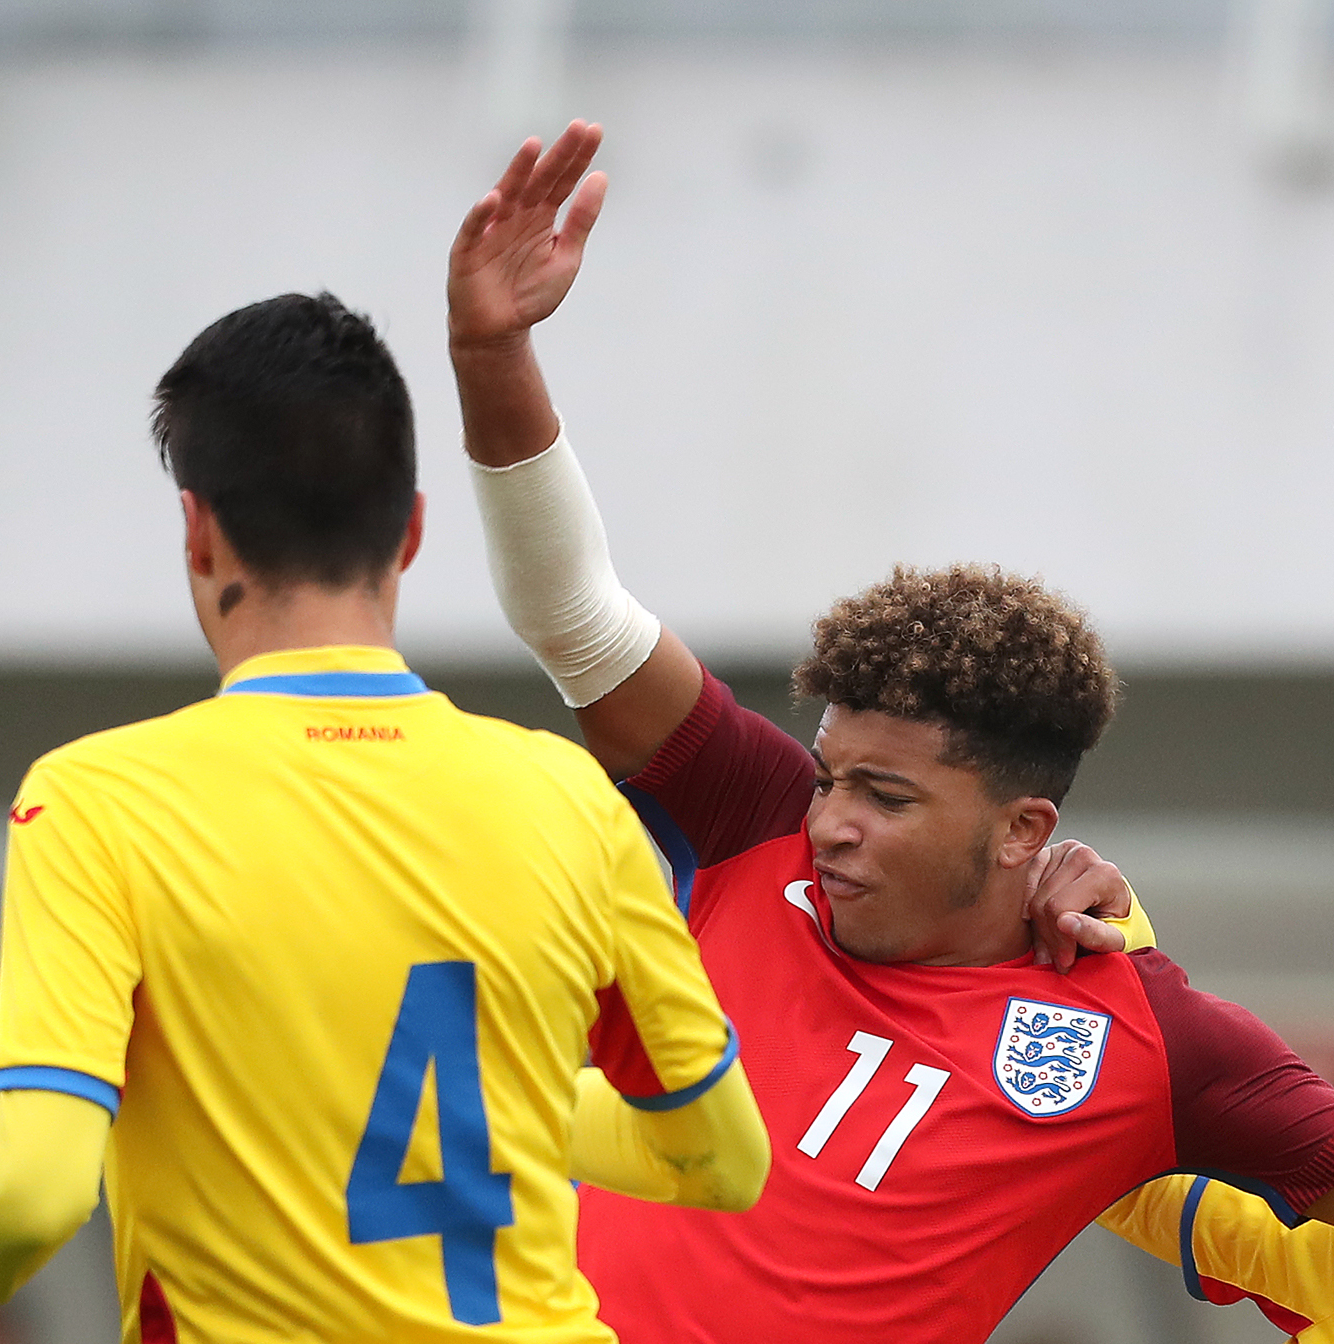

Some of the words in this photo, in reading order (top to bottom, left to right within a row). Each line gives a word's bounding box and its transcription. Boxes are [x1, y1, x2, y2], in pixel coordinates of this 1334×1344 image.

[306, 726, 405, 741] ROMANIA
[346, 960, 515, 1327] 4
[796, 1029, 952, 1192] 11
